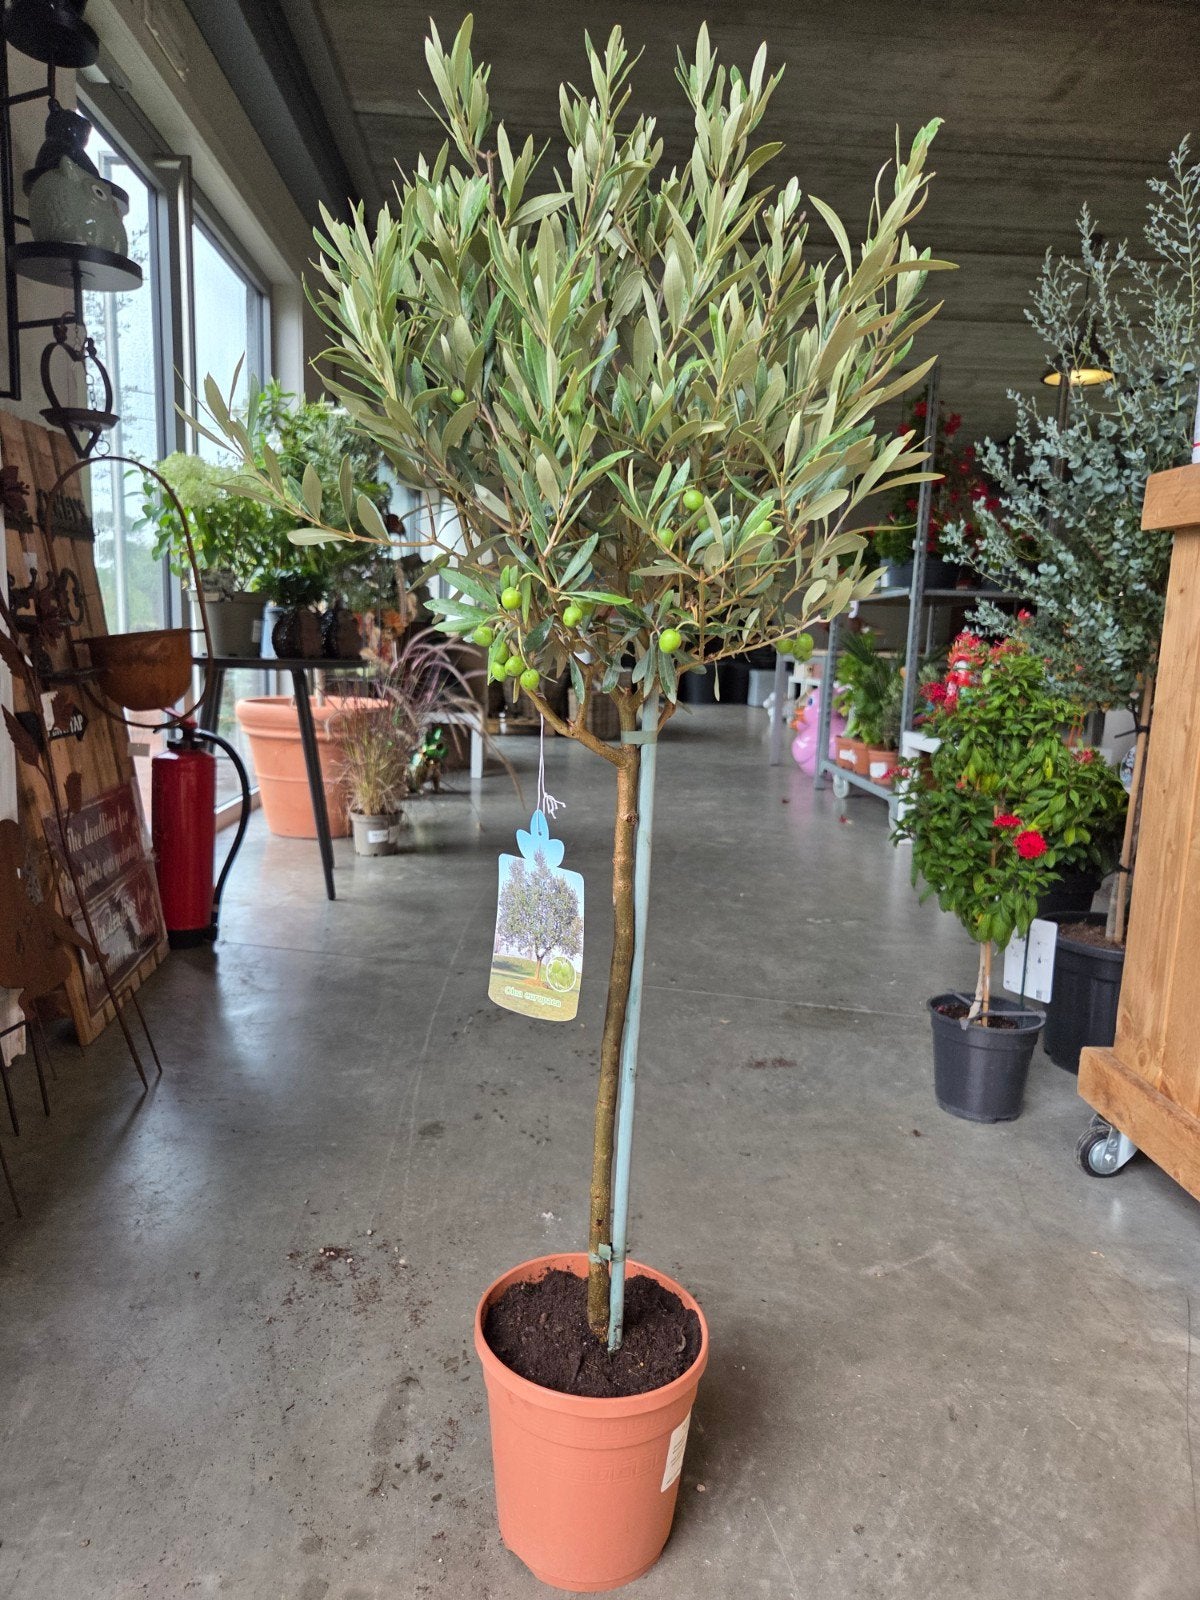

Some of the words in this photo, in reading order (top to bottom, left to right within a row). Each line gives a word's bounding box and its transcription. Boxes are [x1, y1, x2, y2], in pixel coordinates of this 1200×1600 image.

[66, 827, 83, 853] The
[84, 812, 118, 846] deadline
[117, 804, 129, 832] for
